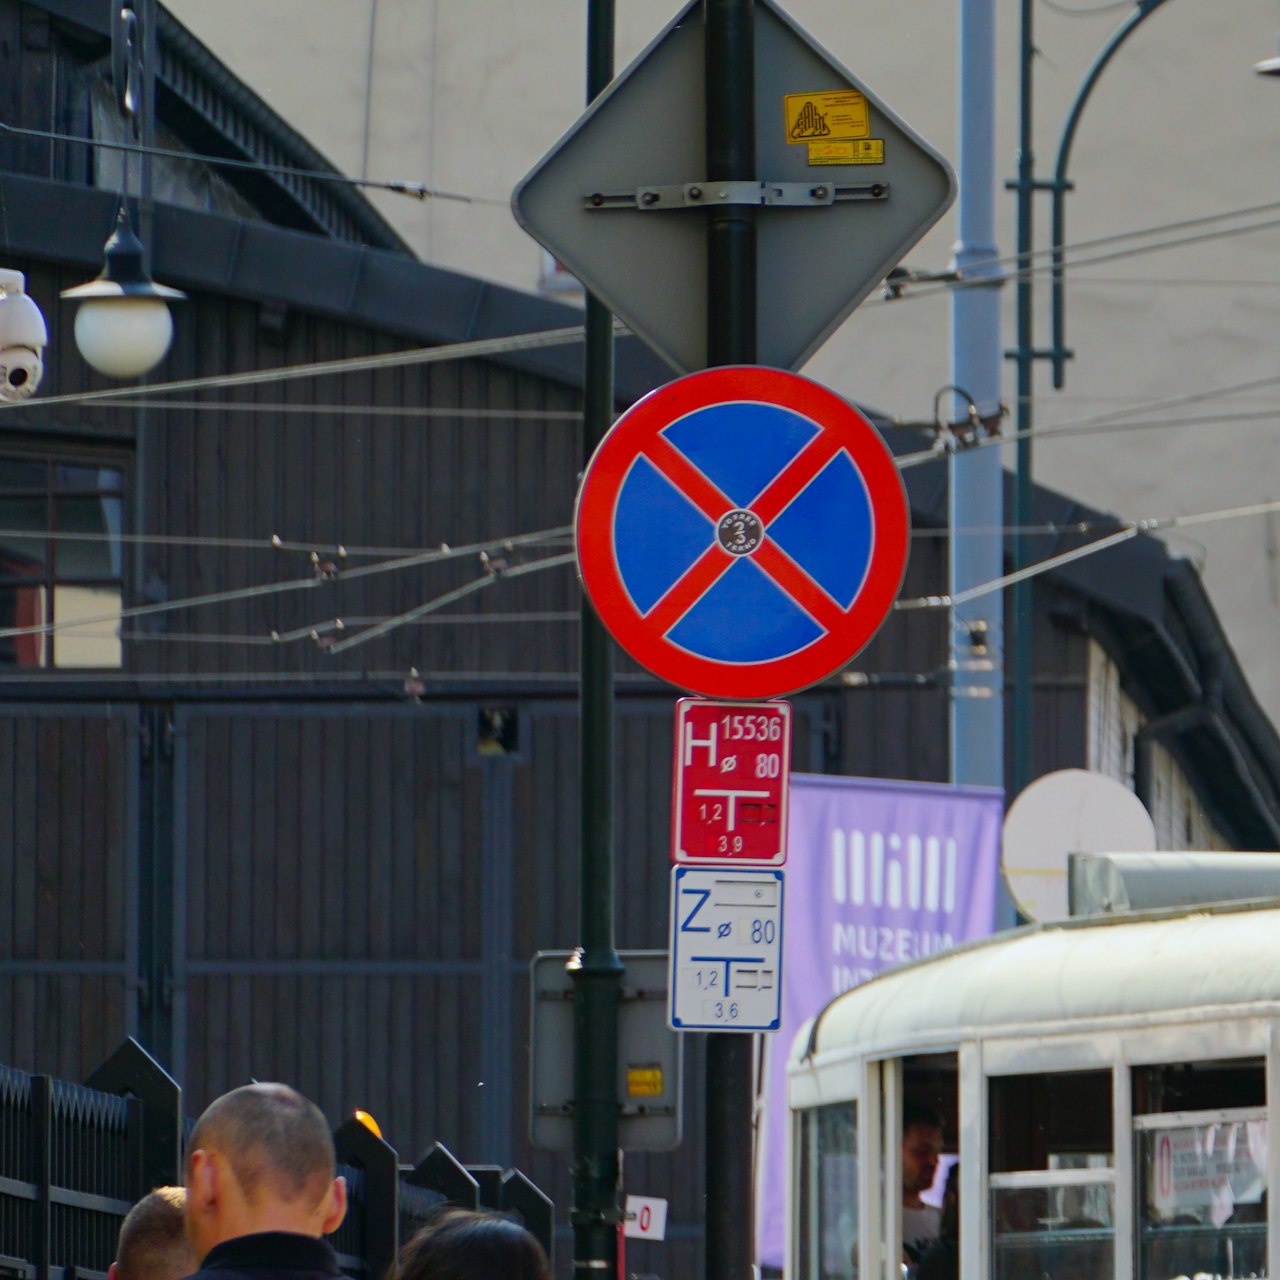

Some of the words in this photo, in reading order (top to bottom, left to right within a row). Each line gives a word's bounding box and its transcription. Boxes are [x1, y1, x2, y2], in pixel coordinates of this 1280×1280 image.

[720, 714, 781, 741] 15536
[684, 721, 717, 767] H
[755, 753, 780, 778] 80
[681, 888, 711, 932] Z
[751, 919, 776, 944] 80
